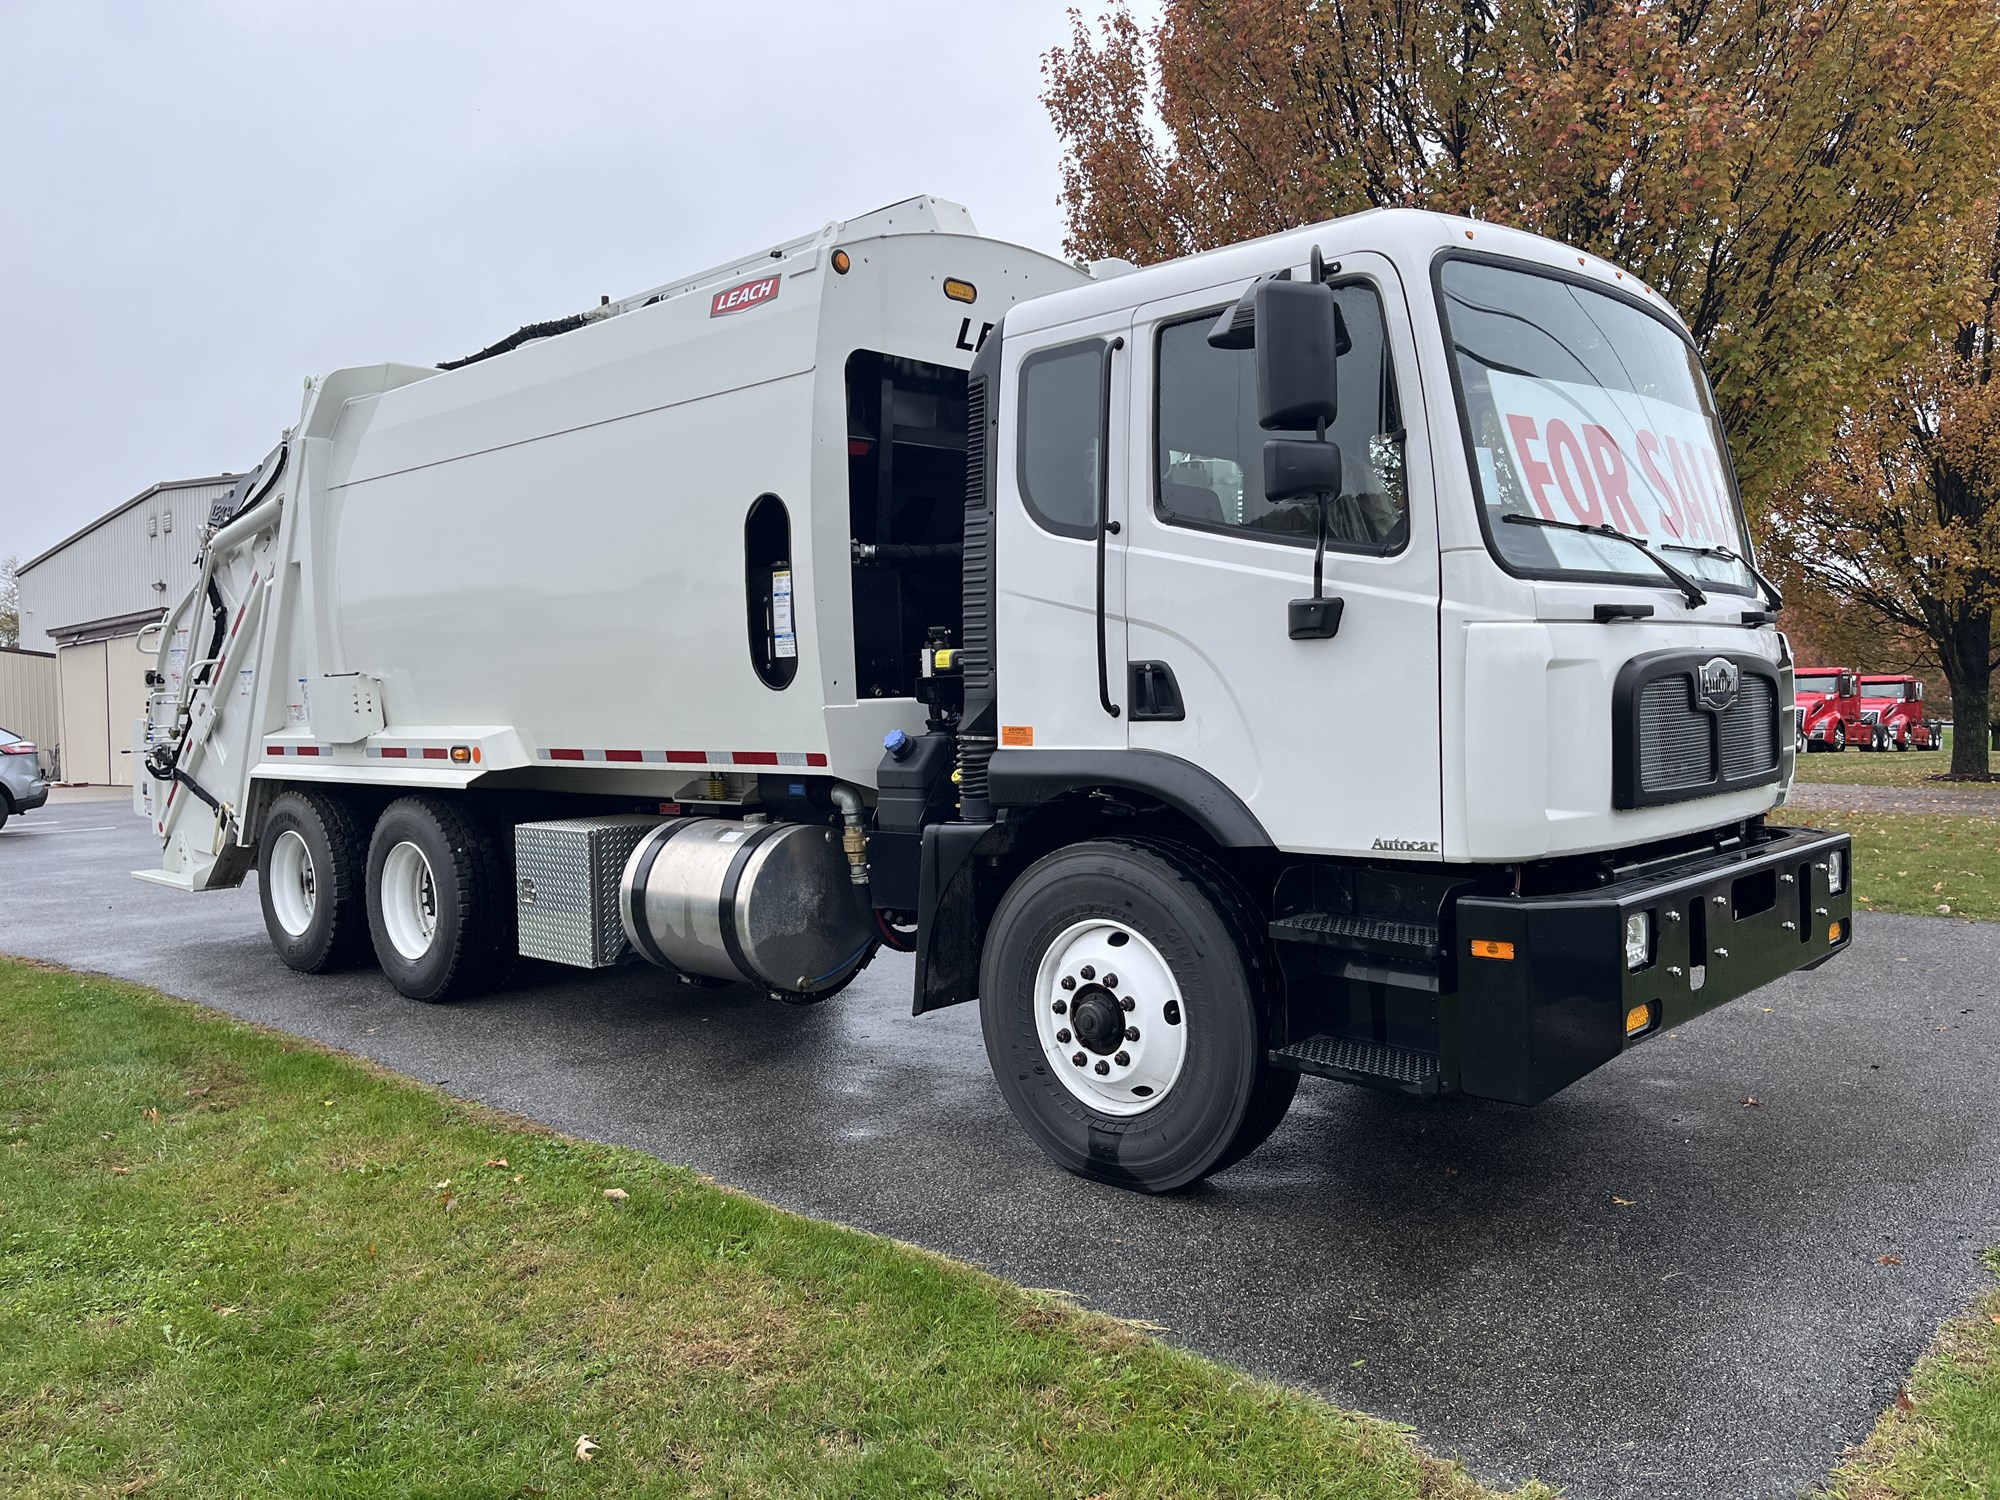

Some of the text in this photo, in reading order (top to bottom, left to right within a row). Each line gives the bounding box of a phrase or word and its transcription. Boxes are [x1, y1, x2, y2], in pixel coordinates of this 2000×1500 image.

[717, 280, 774, 311] LEACH
[1505, 413, 1742, 547] FOR SALE
[1371, 836, 1439, 853] Autocar
